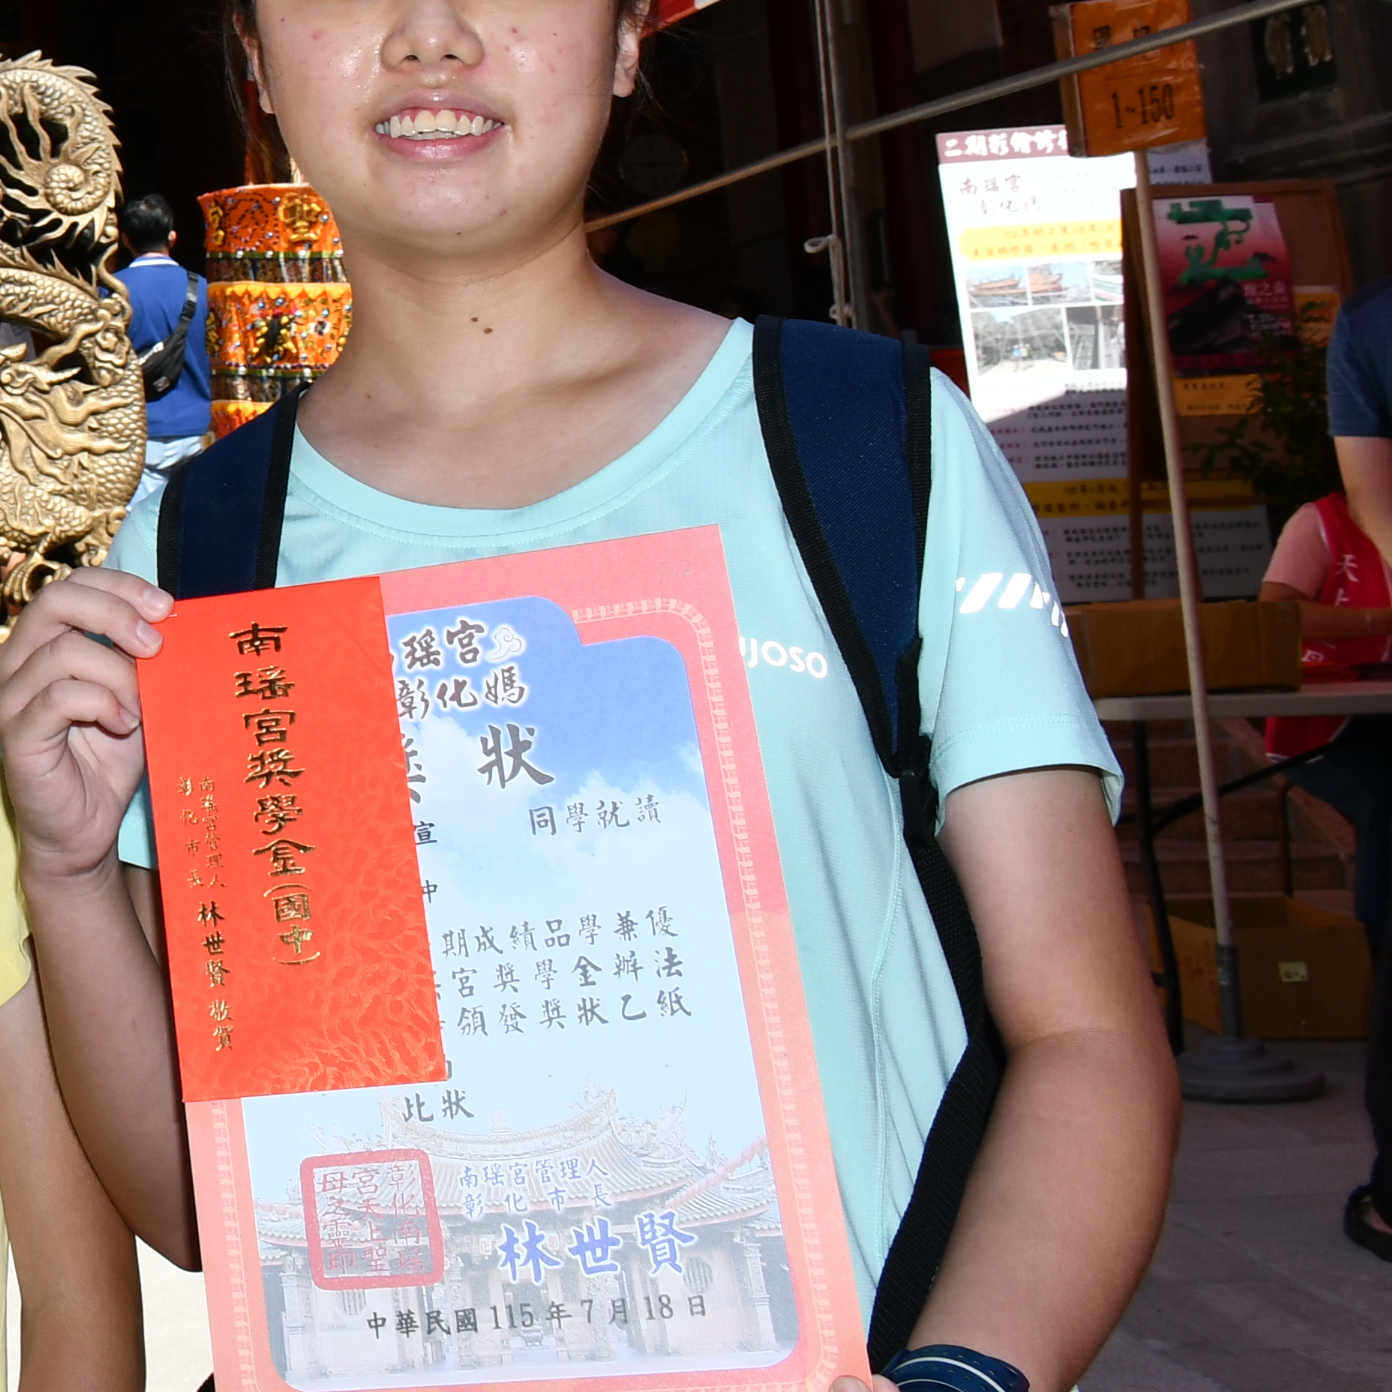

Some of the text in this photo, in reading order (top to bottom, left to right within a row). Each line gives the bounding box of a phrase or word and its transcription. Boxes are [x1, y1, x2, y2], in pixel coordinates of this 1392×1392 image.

[390, 619, 485, 671] 瑤宮
[740, 636, 828, 679] JOSO
[528, 793, 662, 837] 同學就讀
[435, 946, 685, 999] 宮獎學金辦法
[439, 986, 692, 1038] 頒發獎狀乙紙
[459, 1157, 610, 1190] 南瑤宮管理人
[462, 1183, 613, 1219] 彰化市長
[498, 1210, 698, 1286] 林世賢
